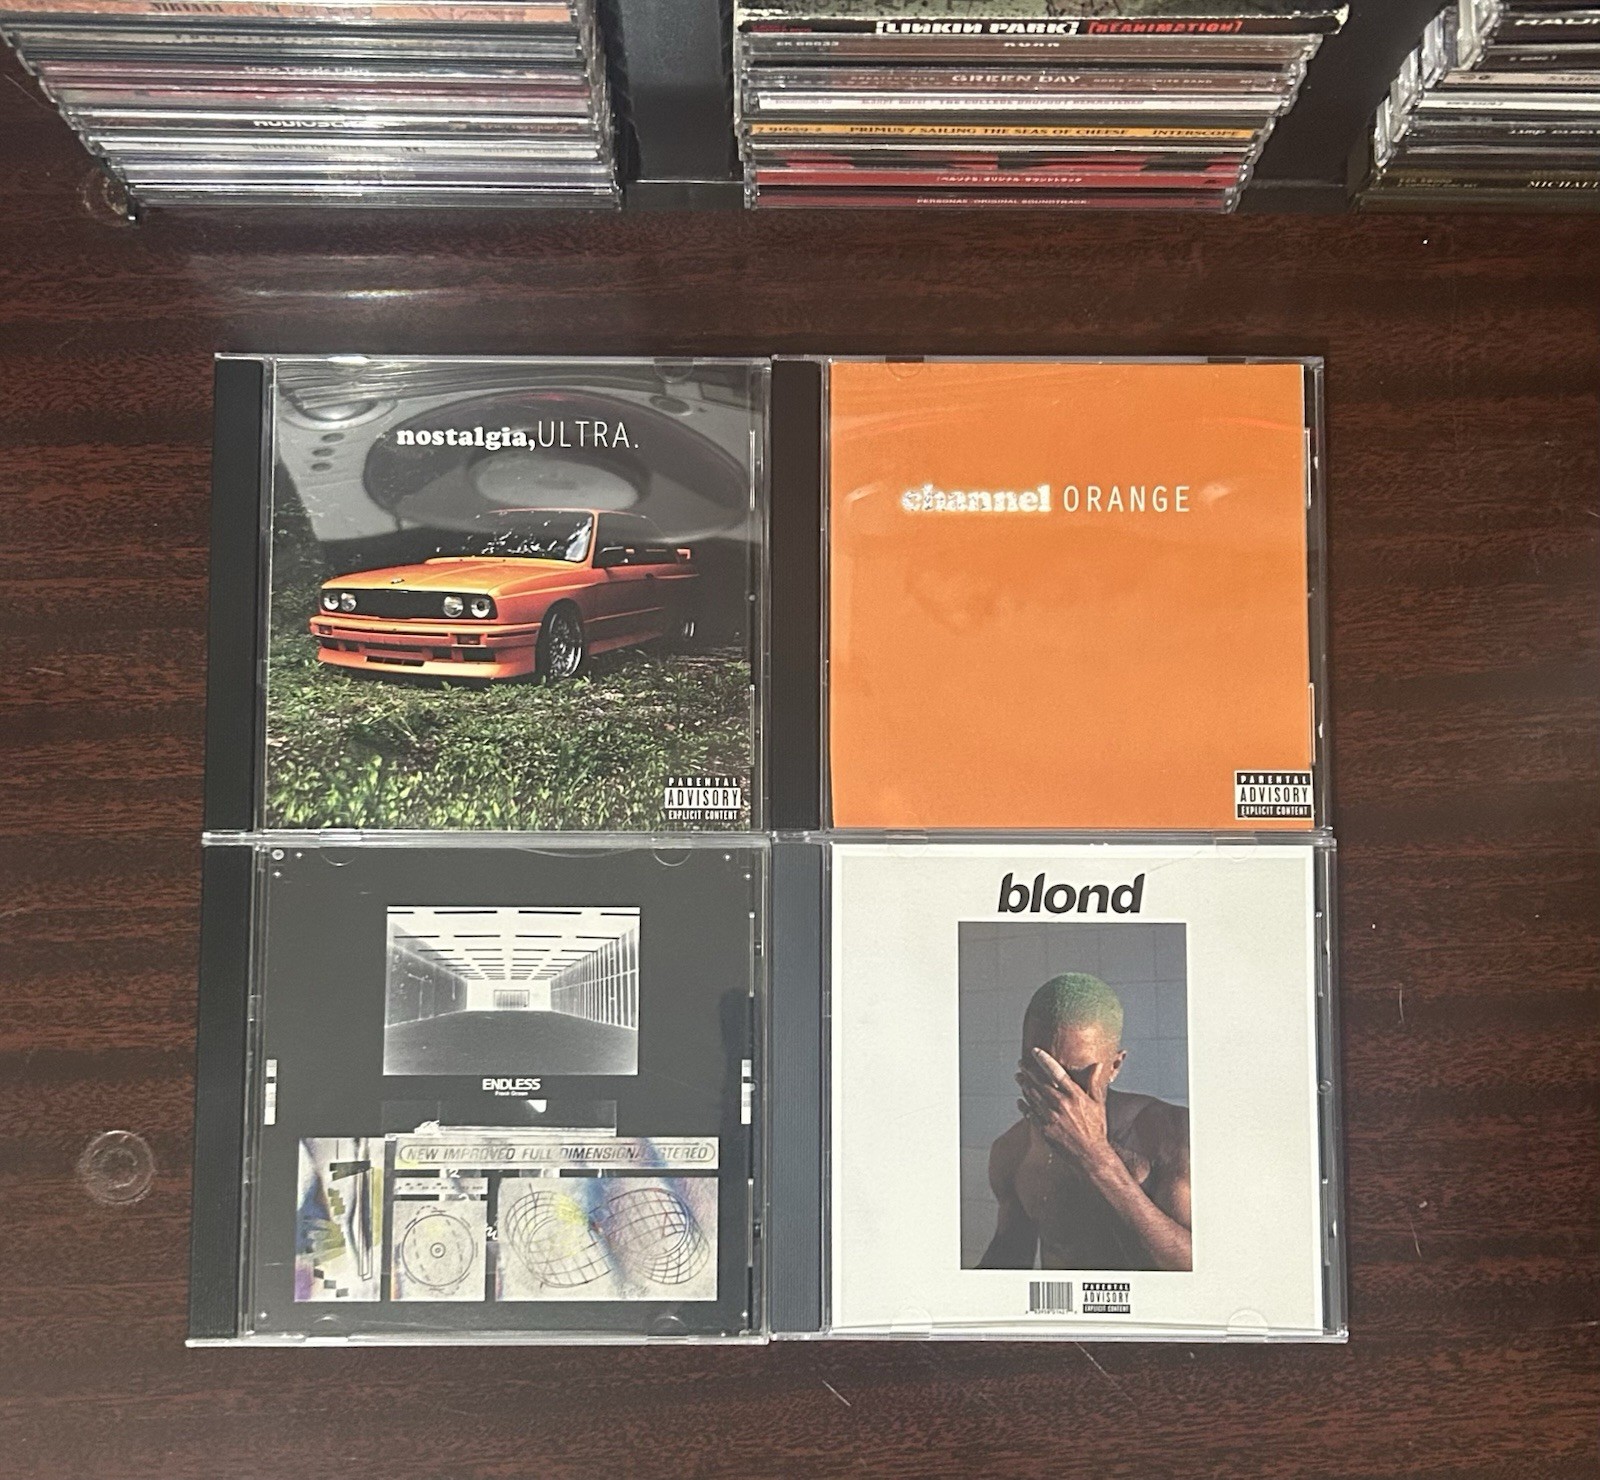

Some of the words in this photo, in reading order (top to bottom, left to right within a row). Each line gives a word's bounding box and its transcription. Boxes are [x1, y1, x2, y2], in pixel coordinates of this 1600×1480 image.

[951, 75, 1032, 83] GREEN
[1038, 75, 1082, 84] DAY
[901, 485, 1051, 512] channel
[1063, 486, 1190, 512] ORANGE
[668, 777, 738, 787] PARENTAL
[1240, 775, 1307, 784] PARENTAL
[668, 789, 738, 806] ADVISORY
[1240, 787, 1308, 803] ADVISORY
[668, 810, 702, 820] EXPLICIT
[704, 810, 738, 820] CONTENT
[1241, 805, 1273, 815] EXPLICIT
[1276, 805, 1308, 815] CONTENT
[998, 872, 1145, 913] blond
[482, 1078, 542, 1090] ENDLESS
[407, 1148, 439, 1160] NEW
[443, 1147, 516, 1160] IMPROVED
[521, 1148, 553, 1160] FULL
[560, 1147, 651, 1160] DIMENSIONA
[1084, 1282, 1129, 1291] PARENTAL
[1084, 1292, 1129, 1303] ADVISORY
